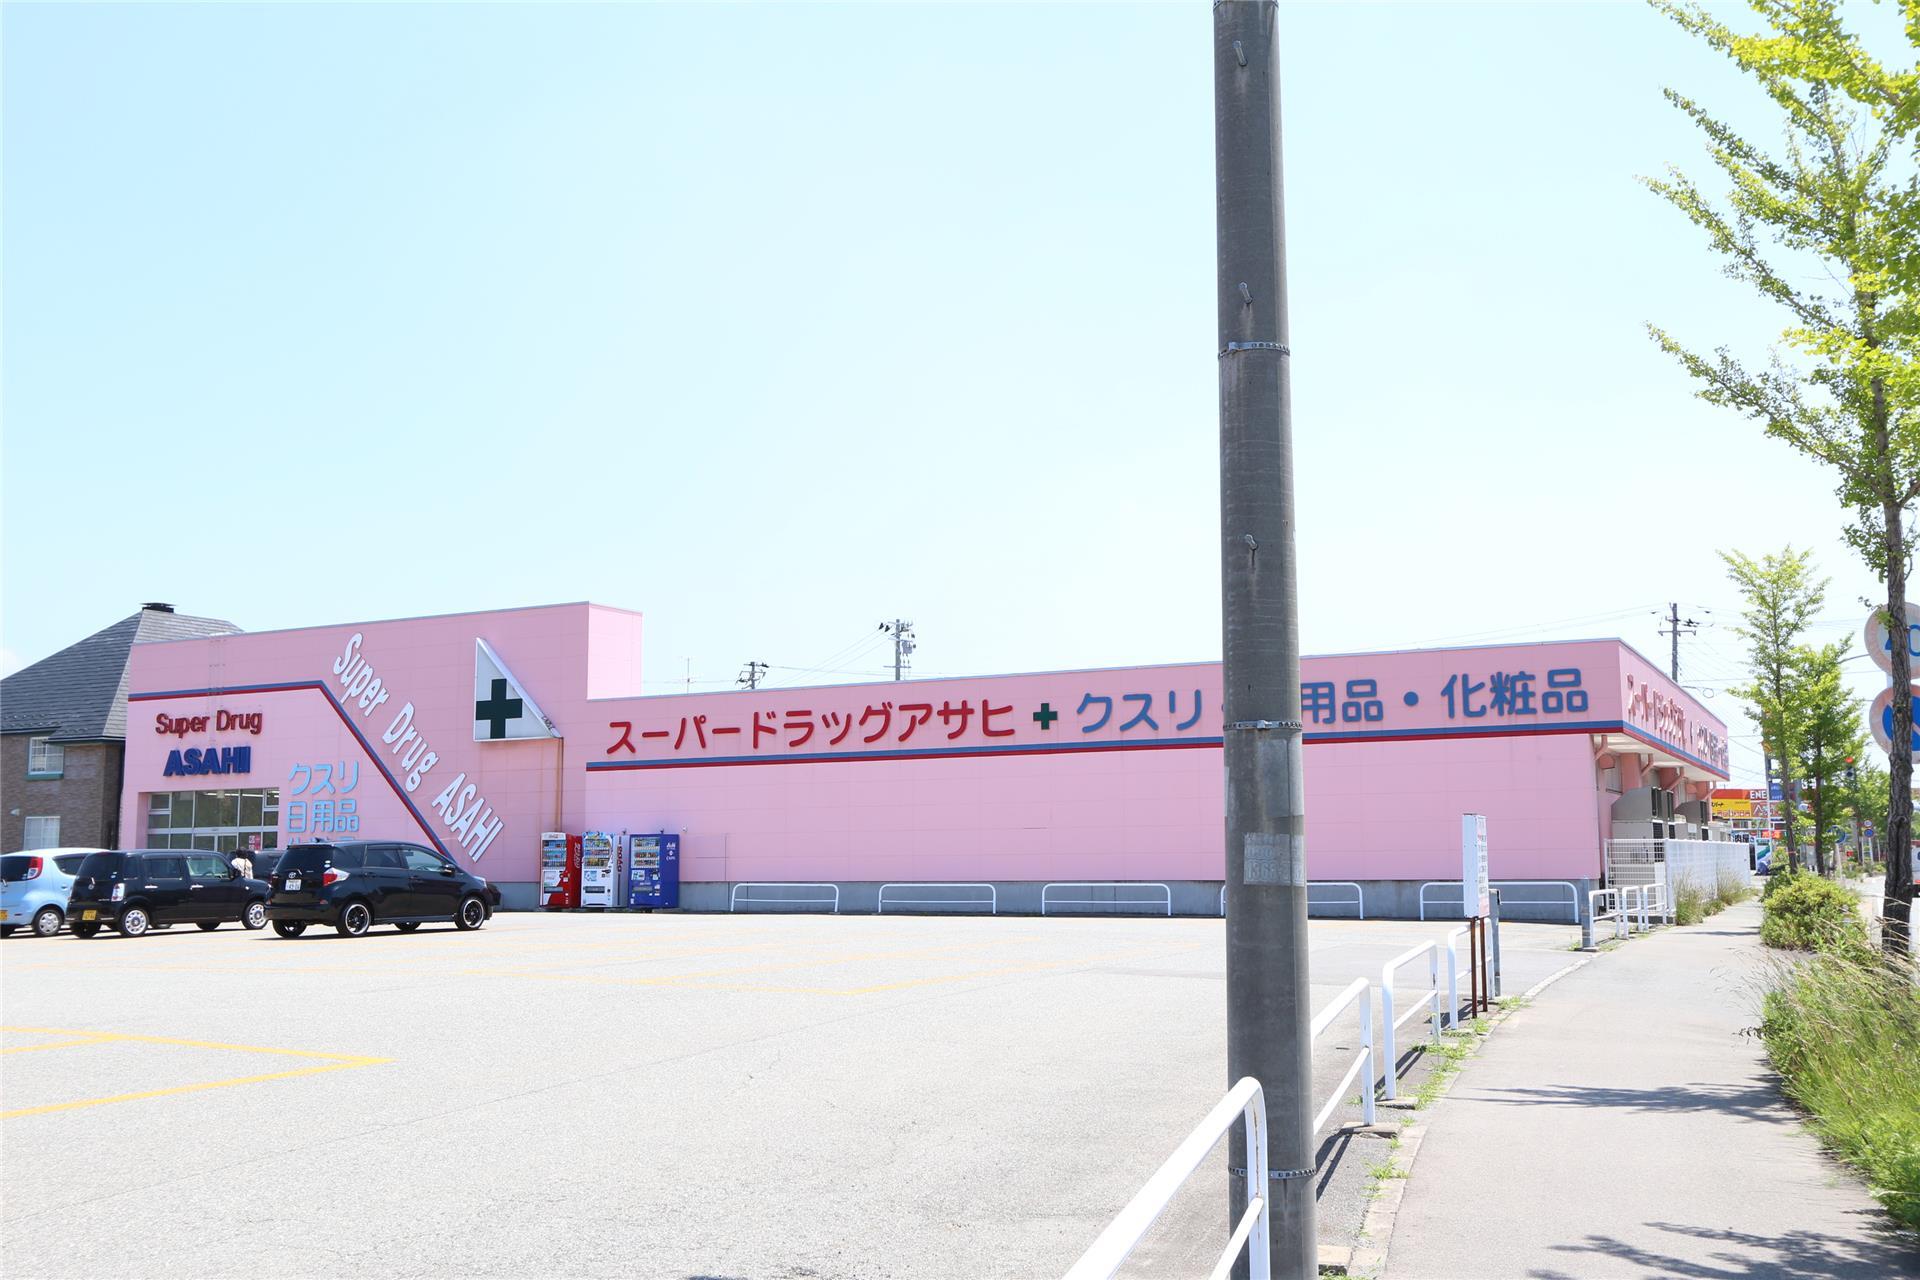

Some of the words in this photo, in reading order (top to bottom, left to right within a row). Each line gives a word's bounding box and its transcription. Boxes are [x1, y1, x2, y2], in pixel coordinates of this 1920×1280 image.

[155, 712, 210, 738] Super
[216, 709, 263, 735] Drug
[606, 699, 1016, 754] スーパードラッグアサヒ
[163, 746, 252, 777] ASAHI
[333, 632, 390, 717] Super
[382, 702, 439, 792] Drug
[431, 772, 504, 863] ASAHI
[288, 760, 360, 795] クスリ
[286, 798, 360, 833] 日用品
